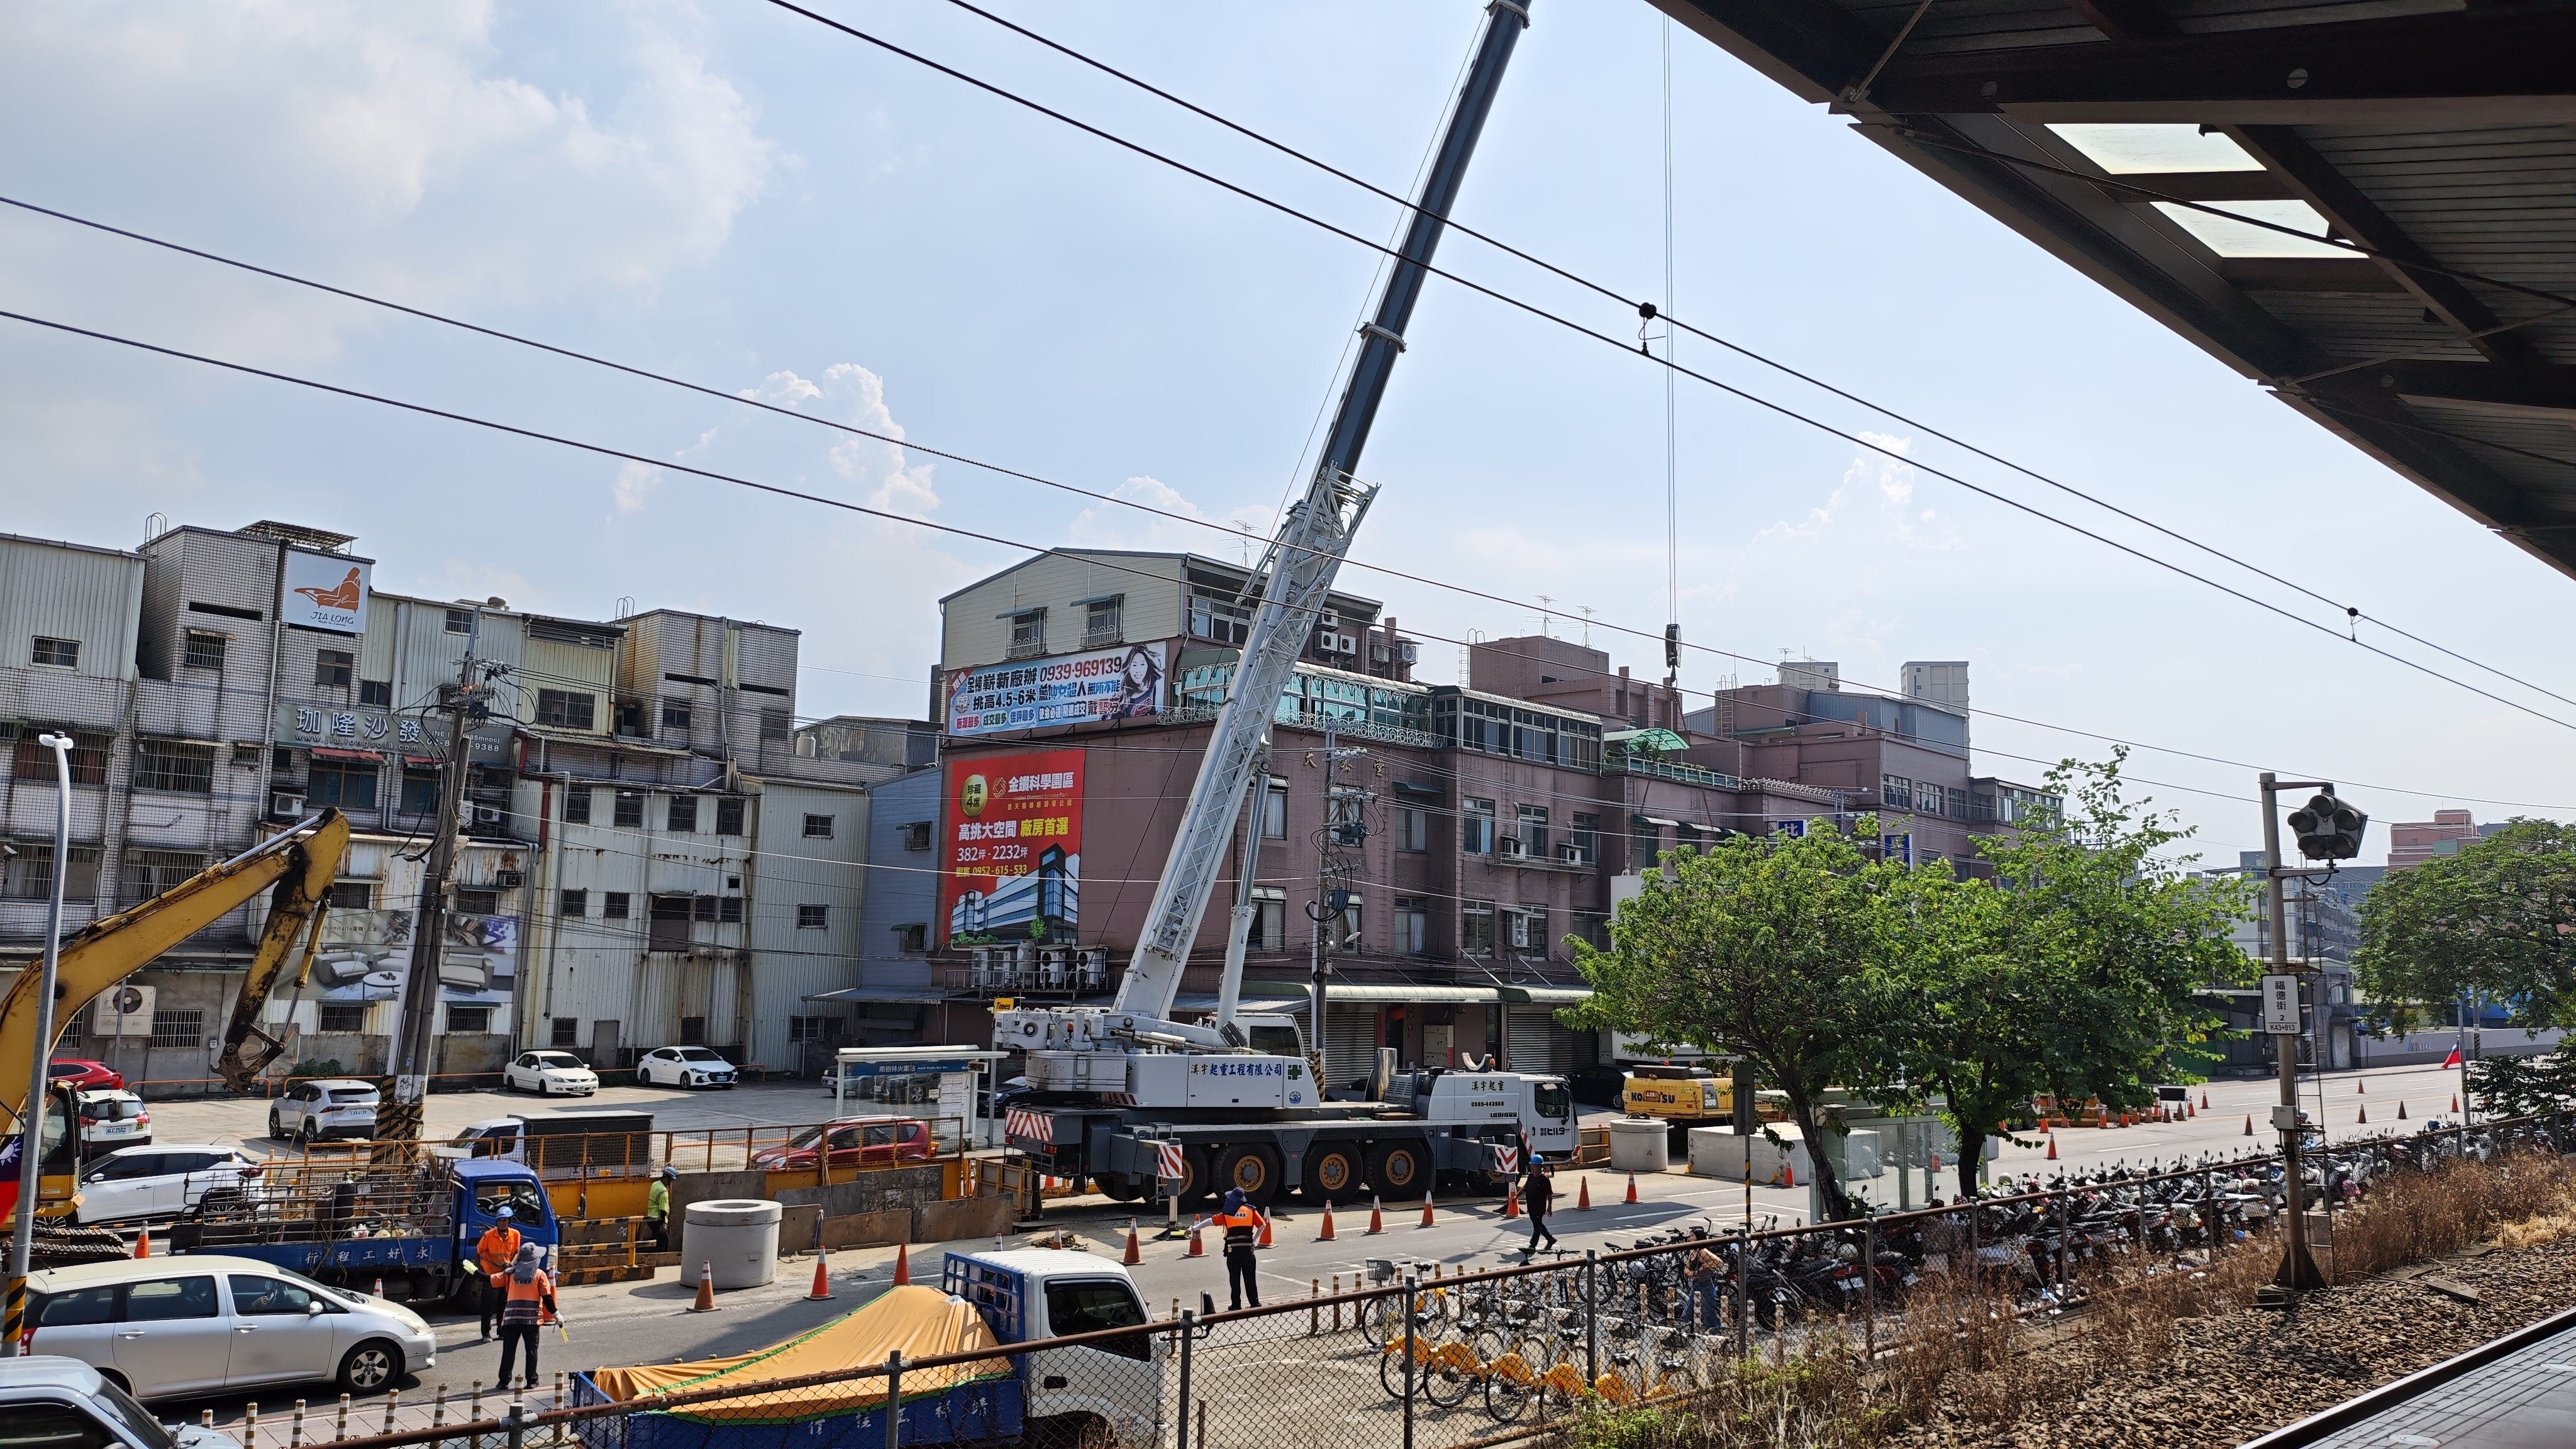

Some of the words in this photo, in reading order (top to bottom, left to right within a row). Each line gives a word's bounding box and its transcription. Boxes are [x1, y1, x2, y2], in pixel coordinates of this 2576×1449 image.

[310, 611, 328, 619] JIA
[331, 614, 354, 625] LONG
[296, 708, 422, 743] 珈隆沙發
[1008, 772, 1074, 793] 金鑽科學園區
[958, 820, 1017, 841] 高挑大空間
[1020, 817, 1069, 837] 廠房首選
[996, 1002, 1011, 1010] Times
[2275, 981, 2287, 1010] 福德街
